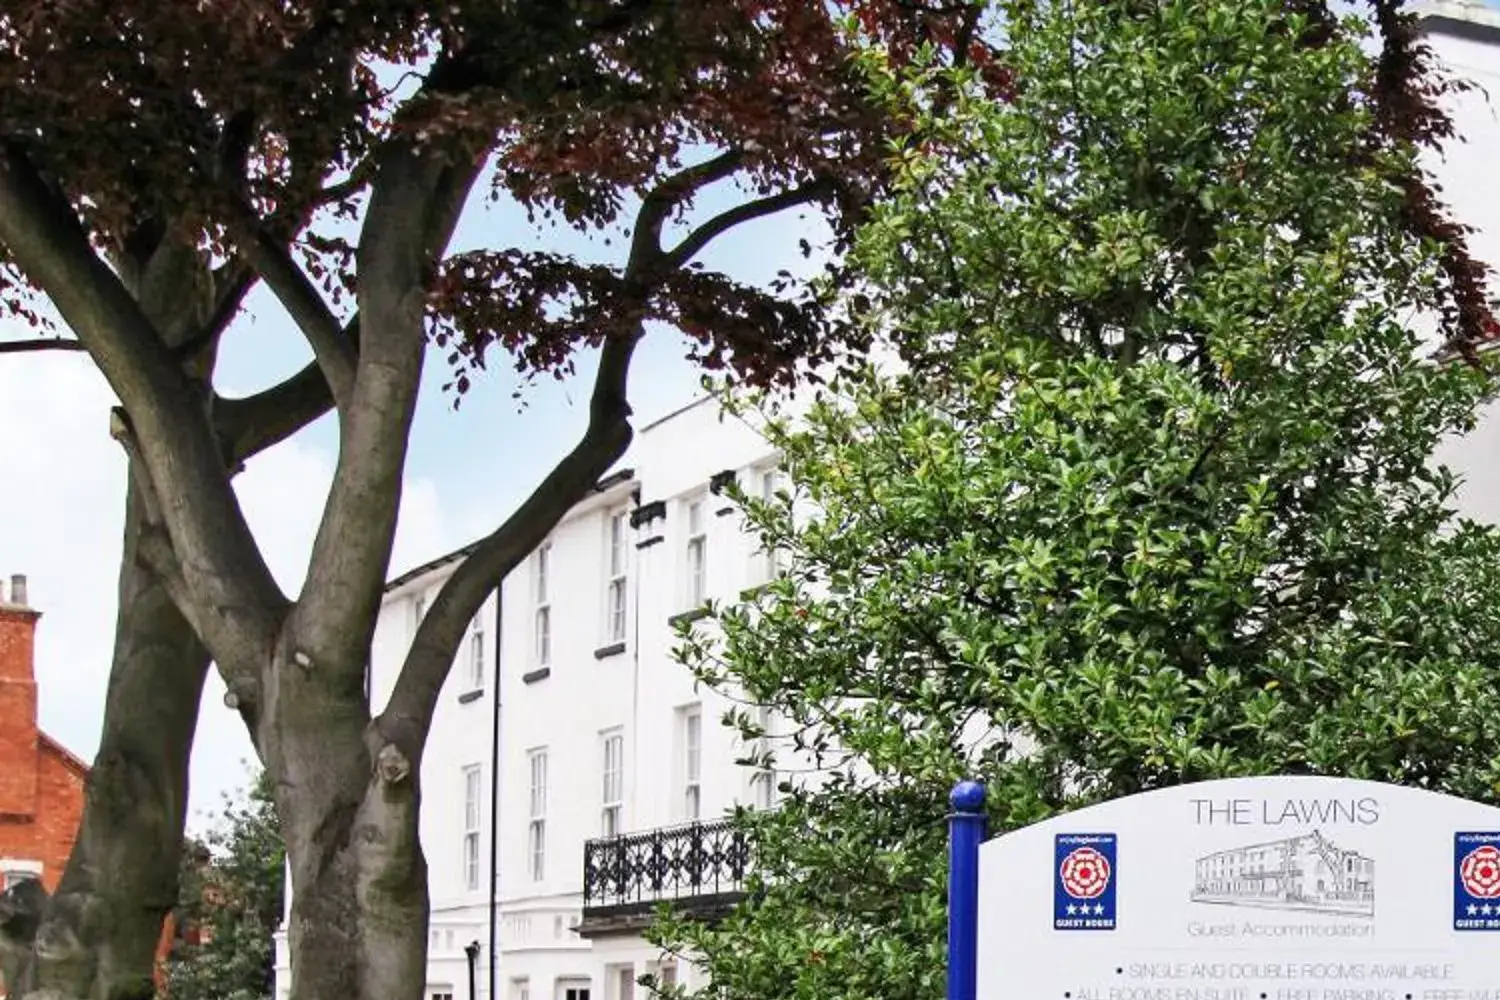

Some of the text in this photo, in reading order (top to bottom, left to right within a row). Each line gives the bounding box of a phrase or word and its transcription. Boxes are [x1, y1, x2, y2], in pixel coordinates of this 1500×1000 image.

[1189, 798, 1380, 825] THE LAWNS
[1055, 919, 1083, 928] GUEST
[1187, 921, 1376, 938] Guest Accommodation
[1455, 919, 1484, 928] GUEST
[1128, 962, 1454, 980] SINGLE AND DOUBLE ROOMS AVAILABLE
